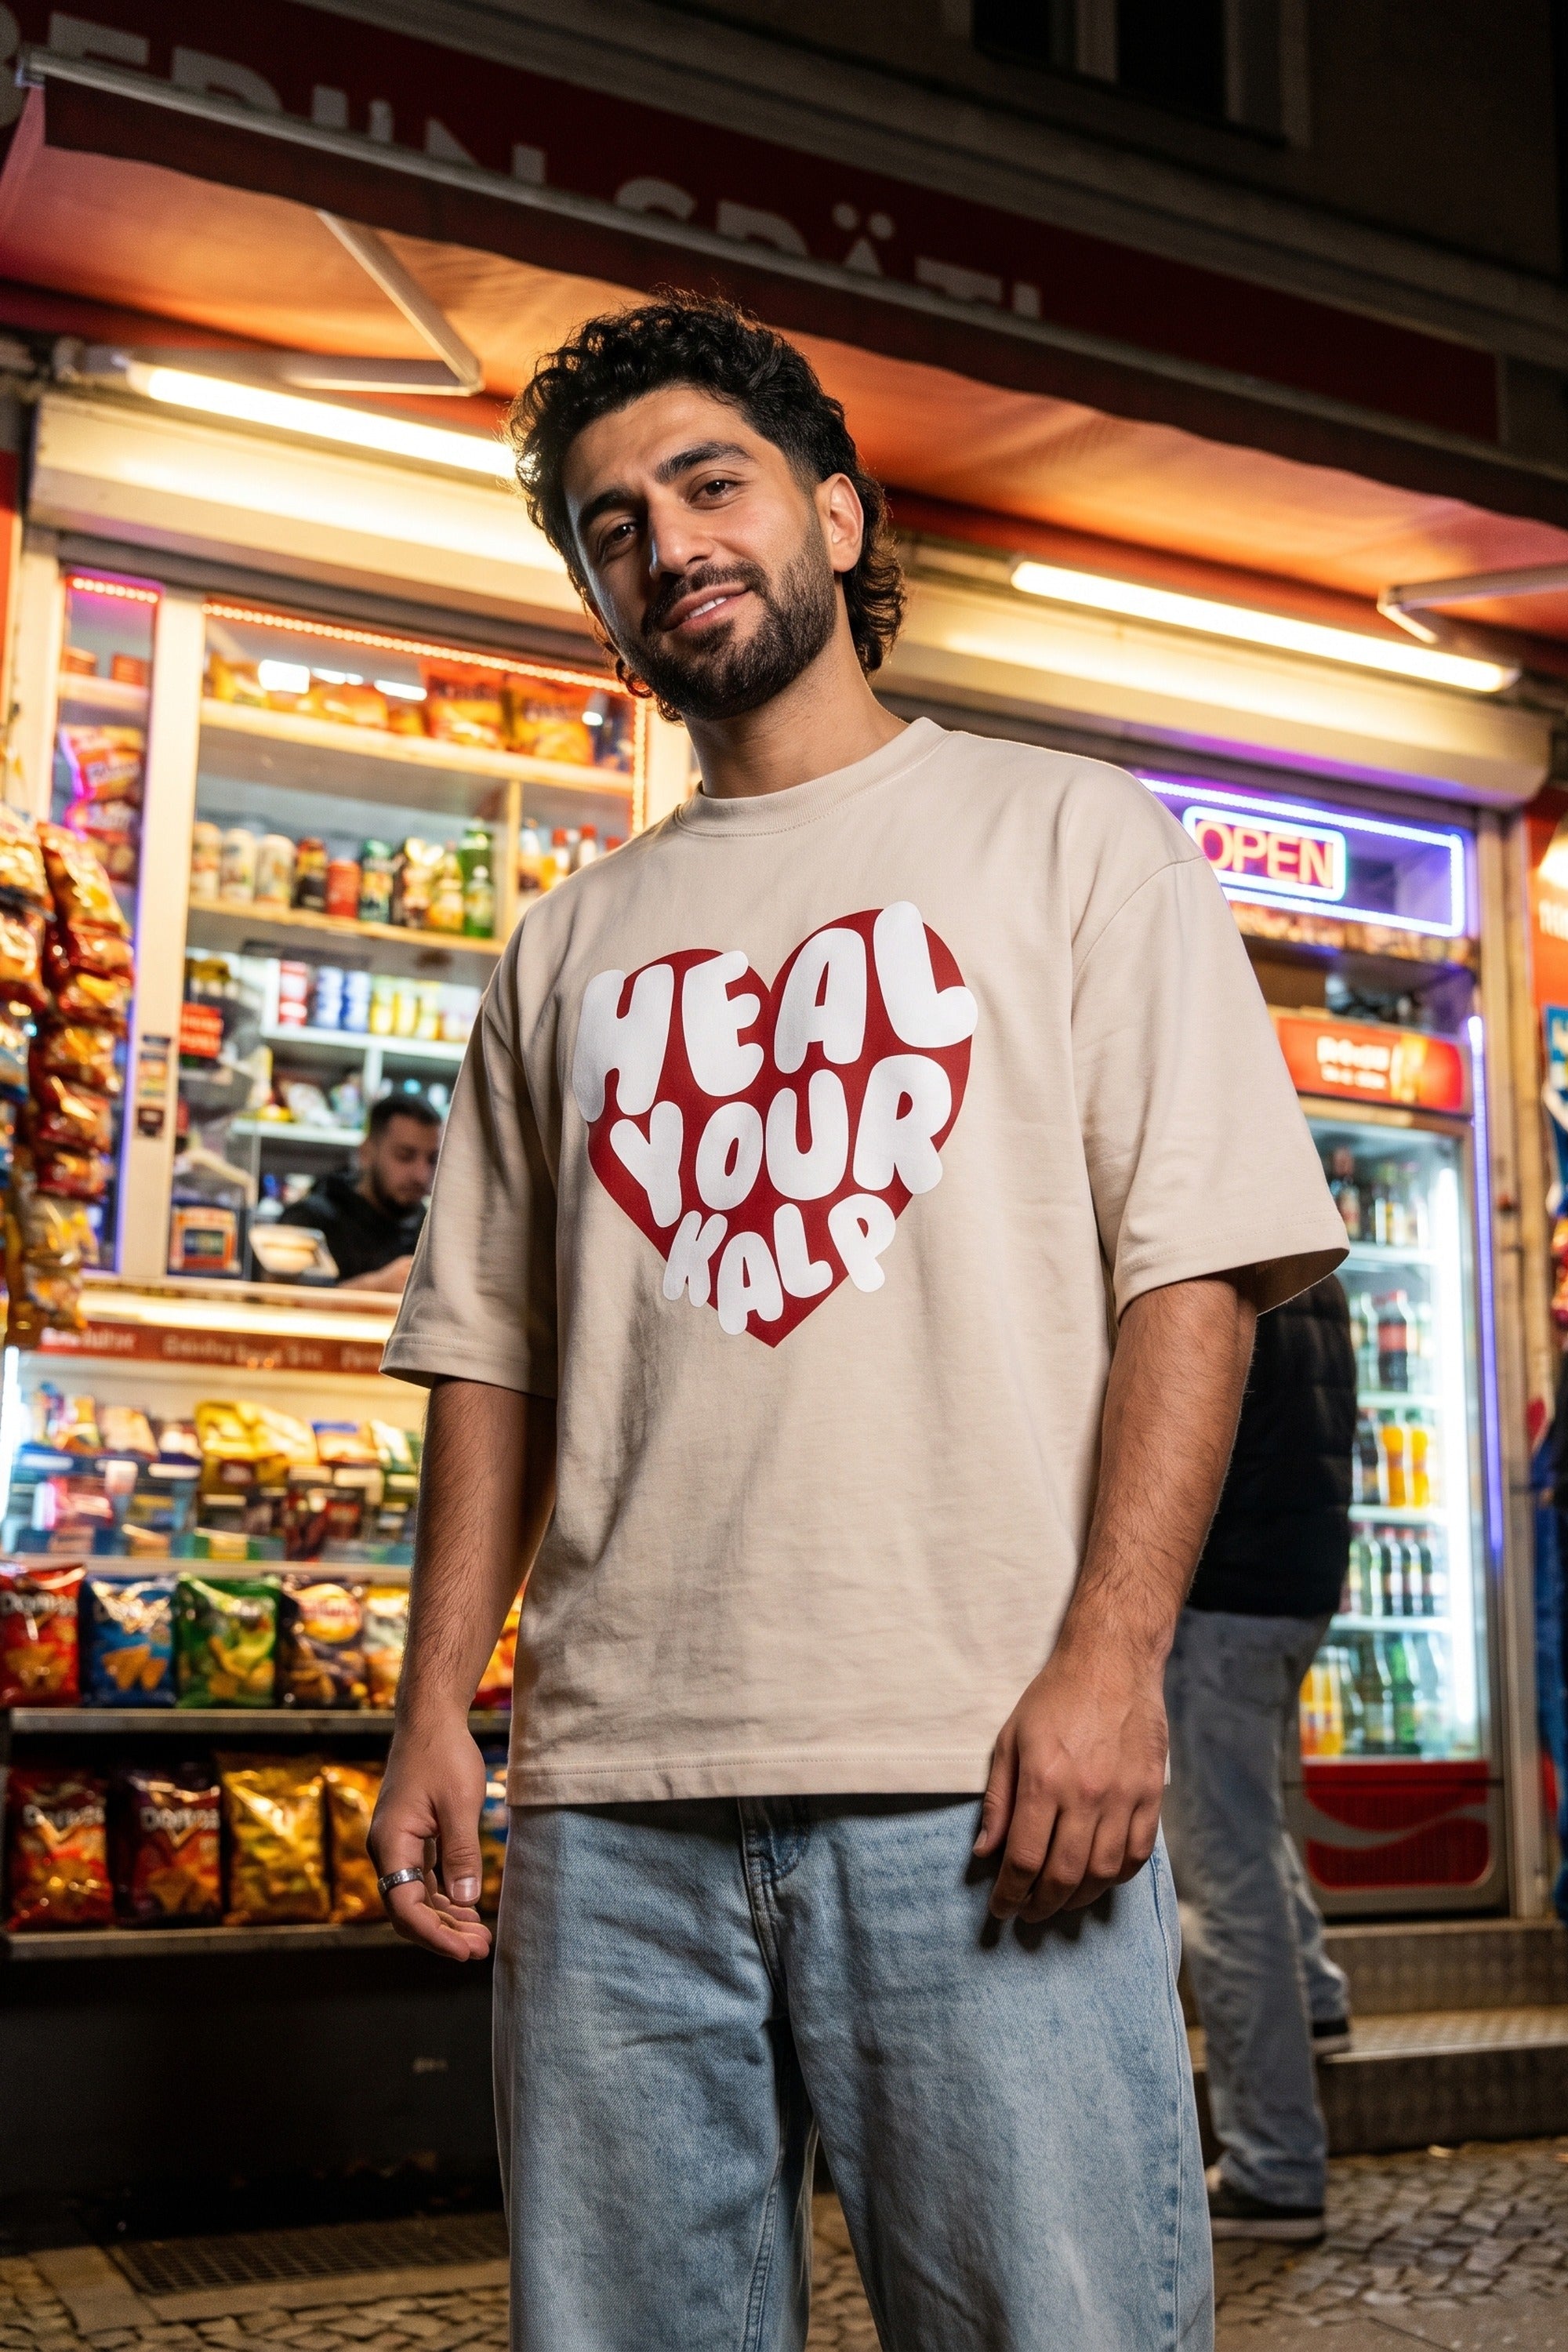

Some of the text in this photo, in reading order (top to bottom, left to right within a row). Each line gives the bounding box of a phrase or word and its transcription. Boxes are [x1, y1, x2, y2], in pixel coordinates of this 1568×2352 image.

[1195, 819, 1334, 889] OPEN
[572, 901, 978, 1122] HEAL
[610, 1054, 952, 1227] YOUR
[662, 1192, 896, 1335] KALP
